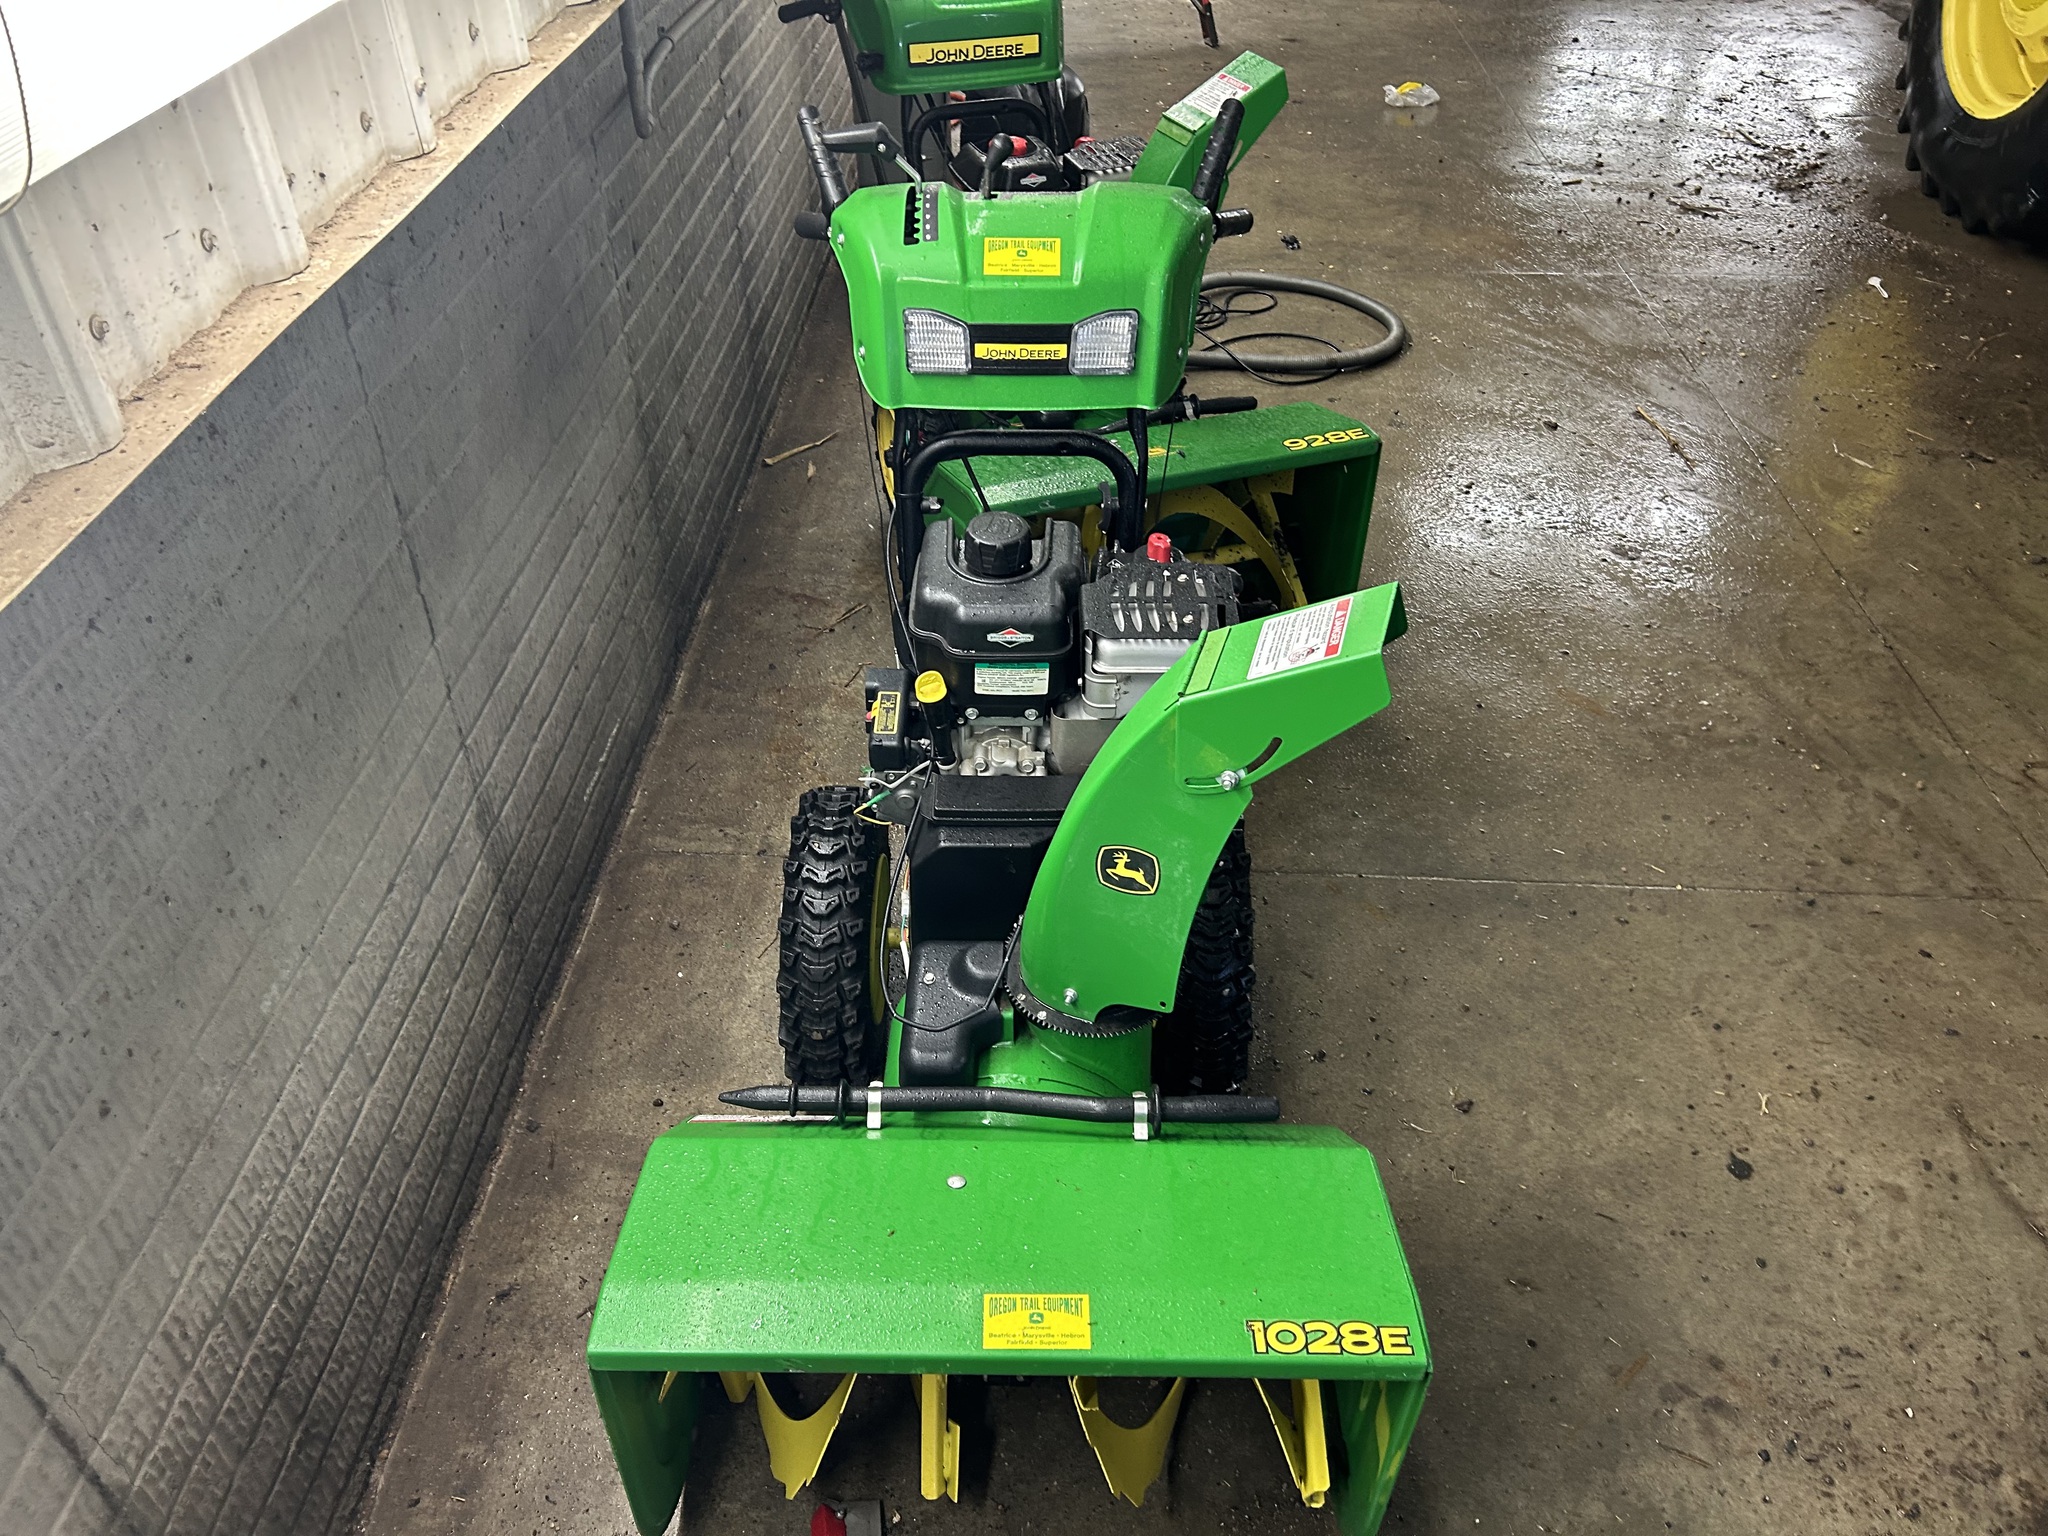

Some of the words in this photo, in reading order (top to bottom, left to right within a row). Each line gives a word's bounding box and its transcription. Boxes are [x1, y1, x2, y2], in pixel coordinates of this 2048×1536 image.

[926, 48, 969, 62] JOHN
[973, 43, 1024, 59] DEERE
[988, 240, 1008, 253] OREGON
[1011, 240, 1025, 248] TRAIL
[1027, 240, 1056, 253] EQUIPMENT
[982, 347, 1016, 358] JOHN
[1020, 348, 1061, 358] DEERE
[1282, 428, 1370, 452] 928E
[1329, 616, 1346, 647] DANGER
[989, 1297, 1017, 1318] OREGON
[1020, 1297, 1040, 1311] TRAIL
[1043, 1297, 1084, 1318] EQUIPMENT
[1246, 1320, 1415, 1356] 1028E
